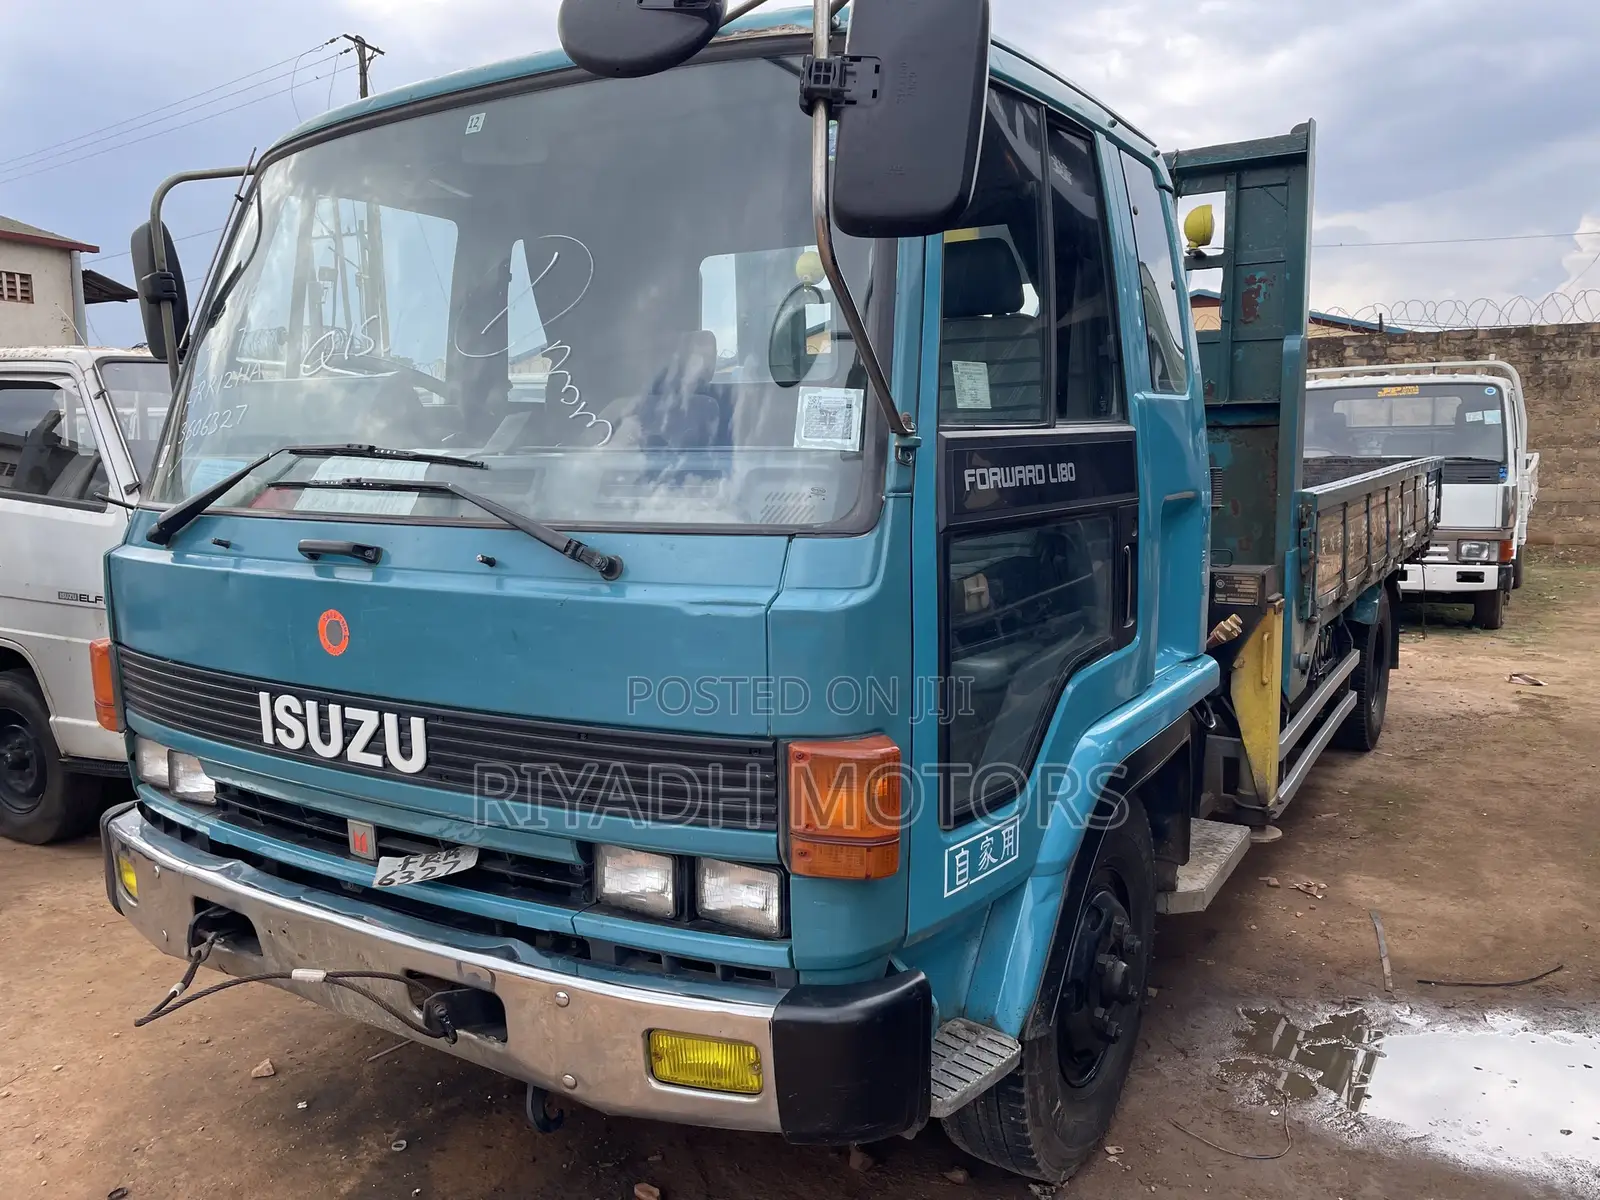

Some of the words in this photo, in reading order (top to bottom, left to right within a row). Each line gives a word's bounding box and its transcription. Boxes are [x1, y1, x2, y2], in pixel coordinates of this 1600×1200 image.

[468, 116, 480, 129] 12
[963, 466, 1046, 492] FORWARD
[1048, 462, 1076, 483] L180
[58, 591, 78, 601] ISUZU
[79, 593, 106, 605] ELF
[259, 691, 427, 774] ISUZU
[954, 824, 1016, 886] 自家用
[377, 860, 462, 887] 6327
